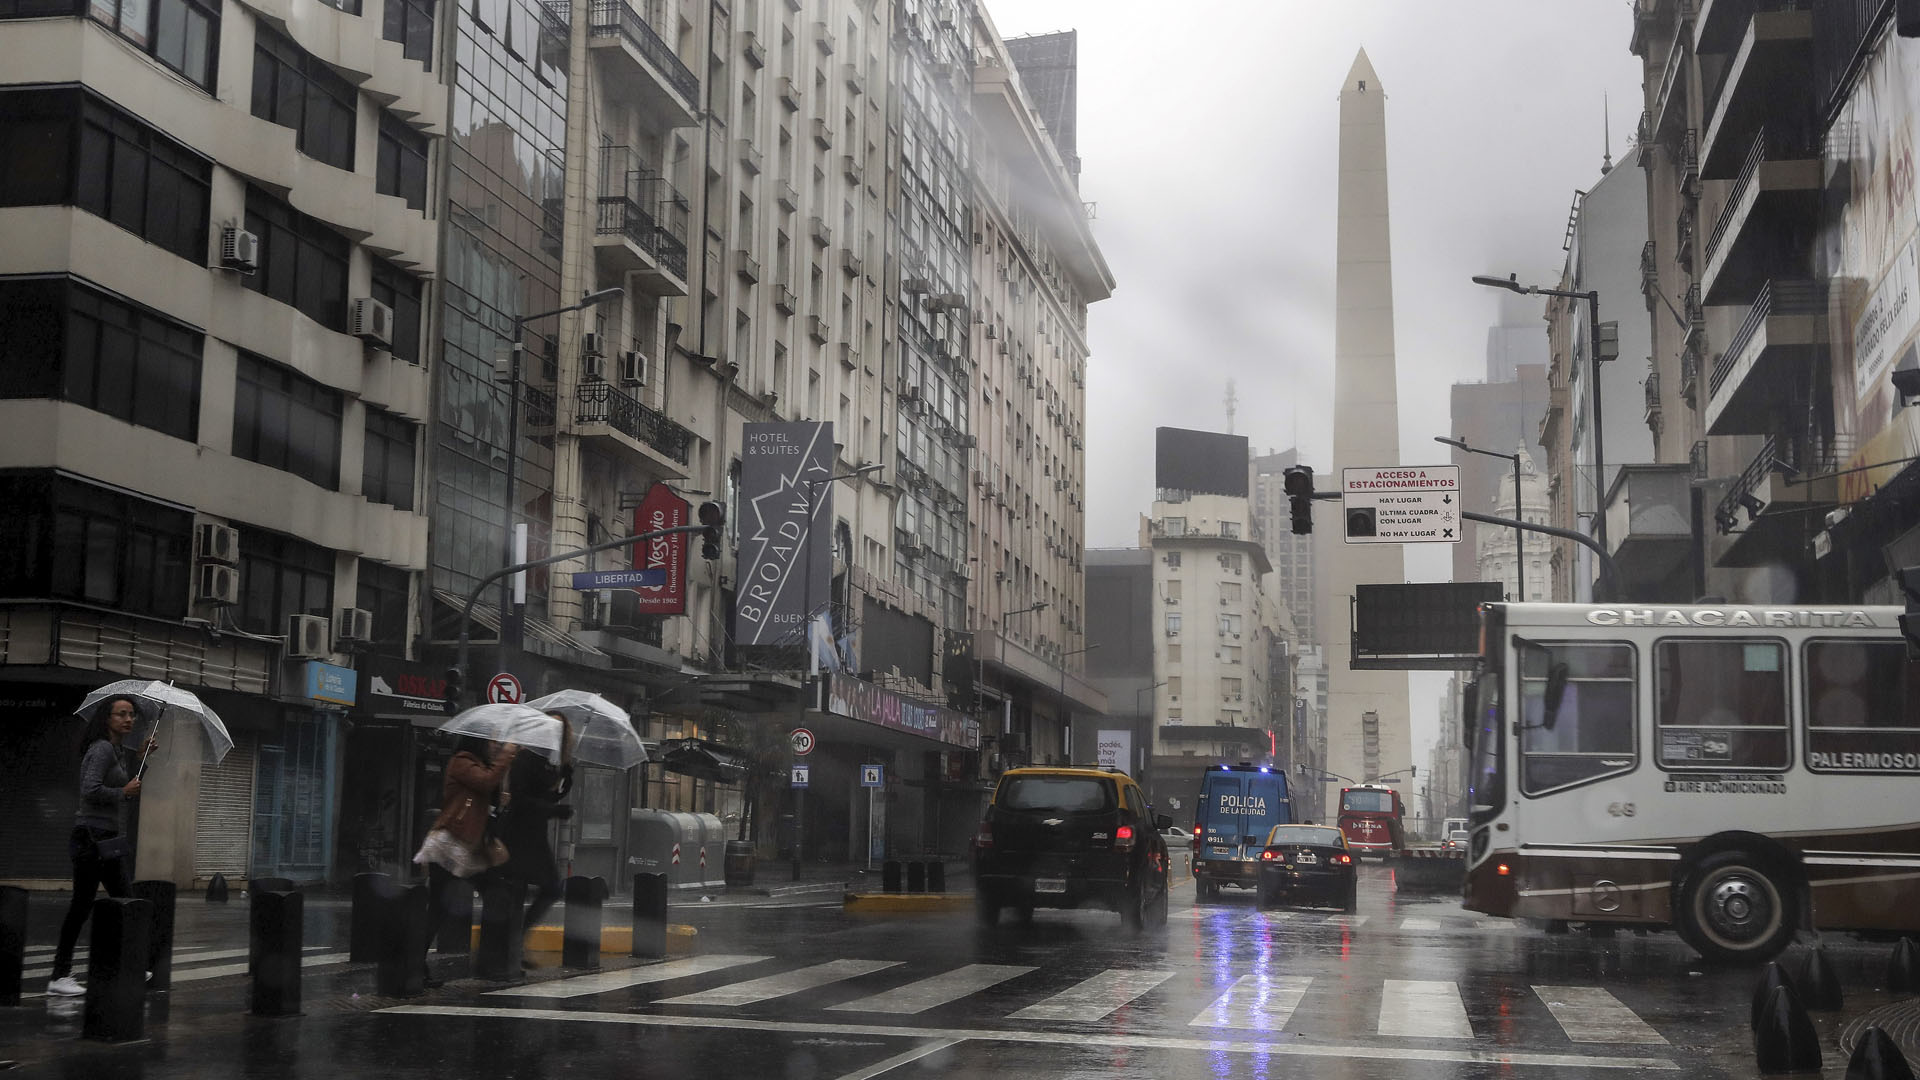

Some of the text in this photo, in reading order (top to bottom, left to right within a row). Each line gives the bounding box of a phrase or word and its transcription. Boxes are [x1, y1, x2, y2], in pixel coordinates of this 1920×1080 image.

[750, 433, 789, 442] HOTEL
[749, 445, 800, 454] & SUITES
[1376, 471, 1416, 479] ACCESO
[1349, 479, 1455, 489] ESTACIONAMIENTOS
[740, 456, 829, 623] BROADWAY
[595, 573, 644, 585] LIBERTAD
[1585, 609, 1879, 628] CHACARITA
[793, 736, 808, 747] 40
[1102, 749, 1116, 757] hay
[1679, 782, 1787, 794] AIRE ACONDICIONADO
[1220, 794, 1266, 808] POLICIA
